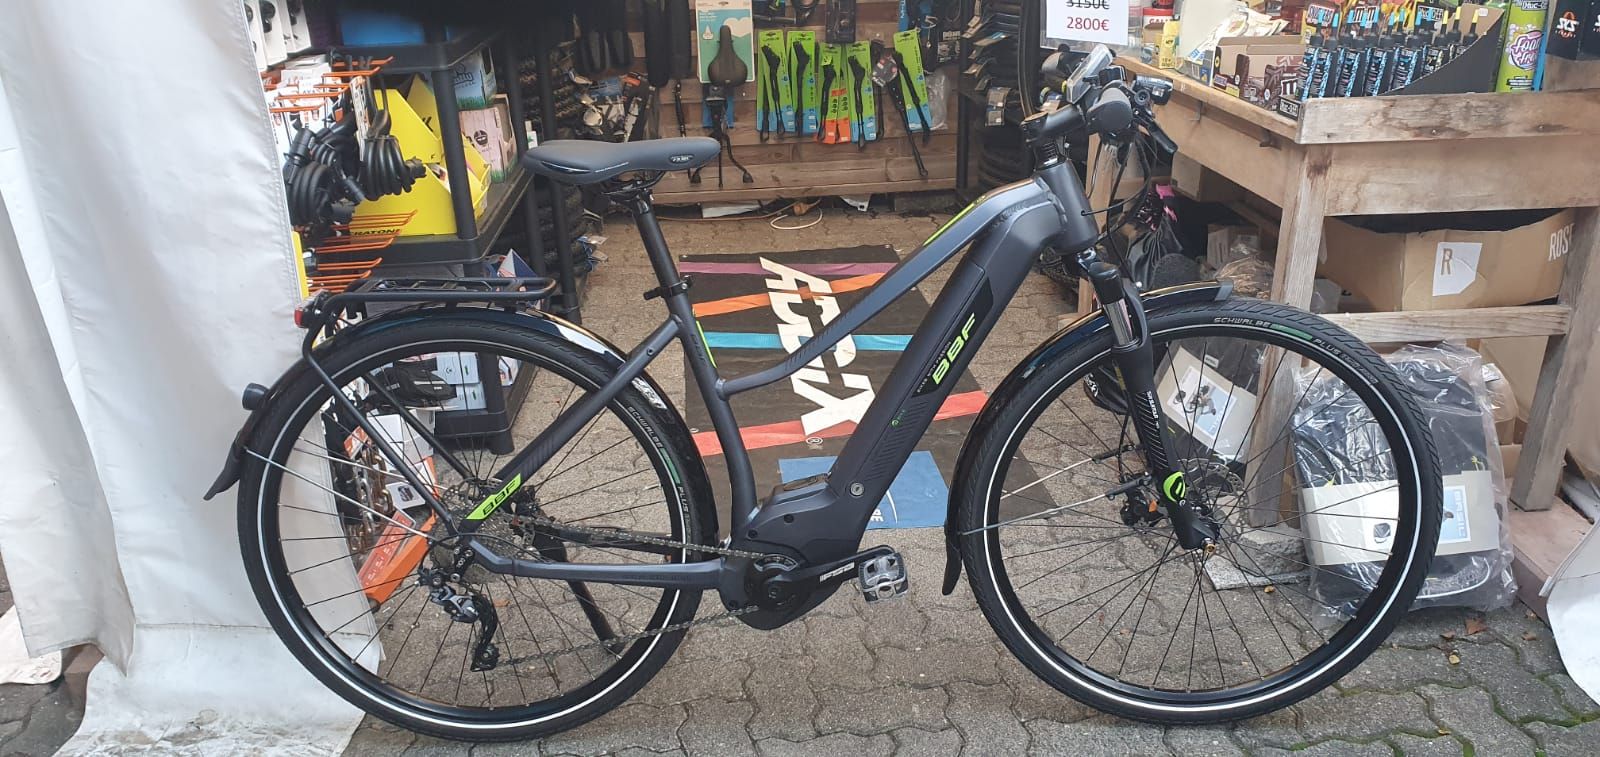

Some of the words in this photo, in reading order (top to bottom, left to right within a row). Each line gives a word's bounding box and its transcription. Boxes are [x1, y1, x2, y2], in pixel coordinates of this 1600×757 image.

[1066, 16, 1110, 31] 2800€
[1440, 247, 1454, 275] R
[931, 312, 976, 384] BBF
[1213, 316, 1271, 328] SCHWALBE
[1313, 338, 1342, 358] PLUS
[627, 406, 664, 448] SCHWALBE
[677, 486, 690, 512] PLUS
[482, 480, 517, 516] BBF
